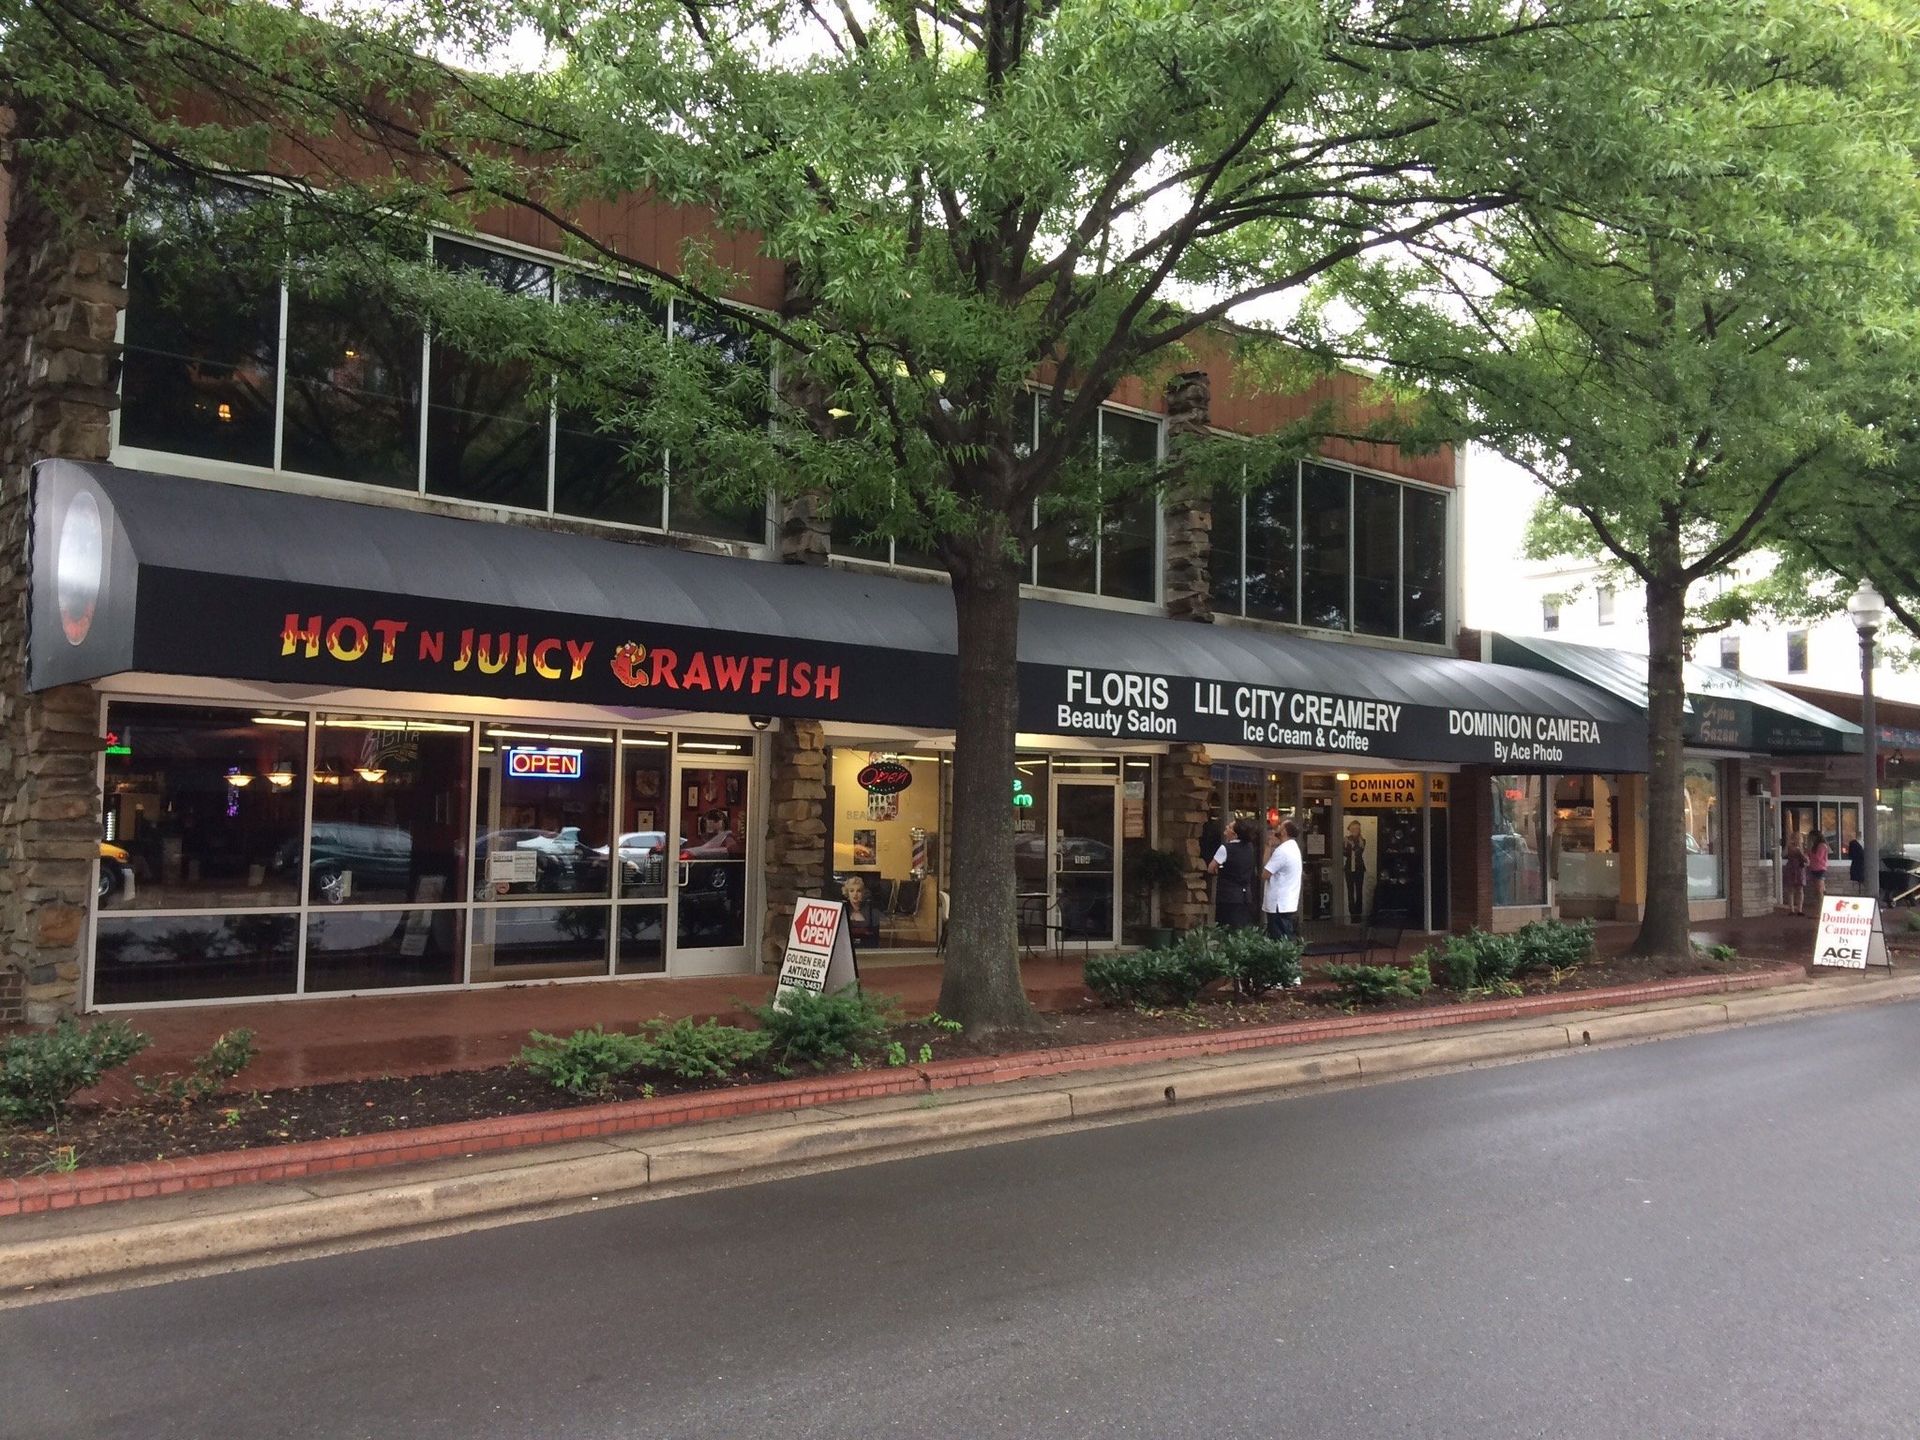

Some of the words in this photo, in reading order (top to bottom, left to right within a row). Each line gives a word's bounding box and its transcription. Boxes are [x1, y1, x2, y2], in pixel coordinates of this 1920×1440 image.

[280, 613, 408, 664] HOT
[418, 630, 444, 663] N
[453, 628, 595, 681] JUICY
[1066, 669, 1170, 710] FLORIS
[1194, 682, 1229, 716] LIL
[1235, 686, 1285, 721] CITY
[1290, 693, 1402, 734] CREAMERY
[1058, 705, 1123, 736] Beauty
[1127, 709, 1177, 735] Salon
[1448, 709, 1532, 739] DOMINION
[1536, 716, 1601, 744] CAMERA
[1243, 720, 1264, 742] Ice
[1268, 722, 1312, 746] Cream
[1315, 728, 1326, 748] &
[1329, 729, 1370, 751] Coffee
[1494, 741, 1509, 763] By
[1510, 742, 1531, 760] Ace
[1533, 743, 1563, 762] Photo
[513, 754, 577, 774] OPEN
[860, 767, 909, 786] Open
[1350, 778, 1416, 790] DOMINION
[1350, 792, 1415, 803] CAMERA
[806, 907, 836, 928] NOW
[1822, 912, 1873, 926] Dominion
[801, 925, 833, 946] OPEN
[1825, 924, 1867, 937] Camera
[786, 953, 811, 967] GOLDEN
[812, 958, 826, 969] ERA
[1823, 947, 1862, 960] ACE
[787, 965, 821, 979] ANTIQUES
